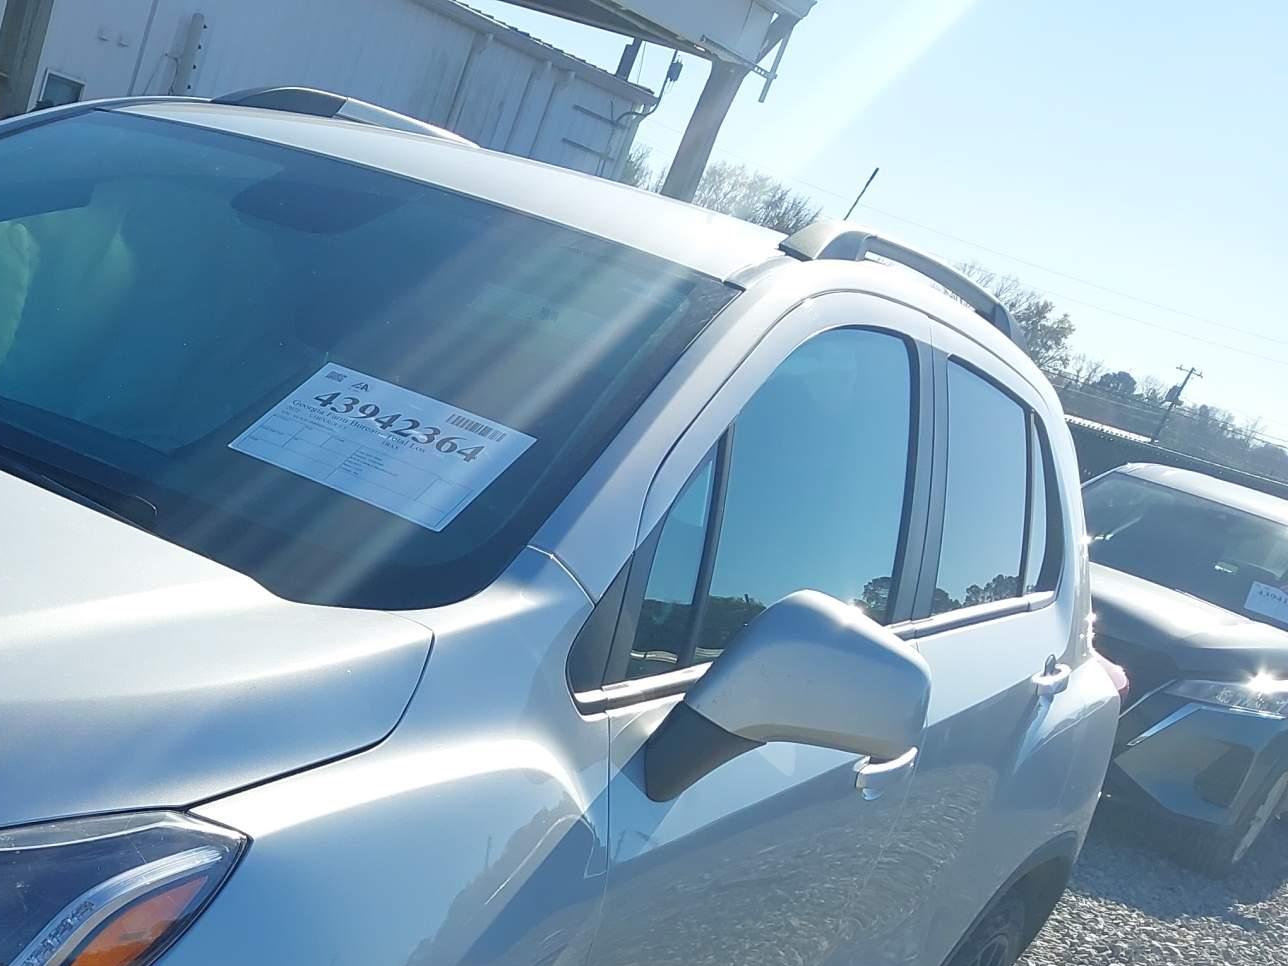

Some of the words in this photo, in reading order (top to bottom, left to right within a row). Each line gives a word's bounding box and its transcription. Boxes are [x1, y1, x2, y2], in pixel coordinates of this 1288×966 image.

[292, 400, 325, 415] Georgia
[326, 411, 349, 424] Farm
[313, 392, 486, 463] 43942364
